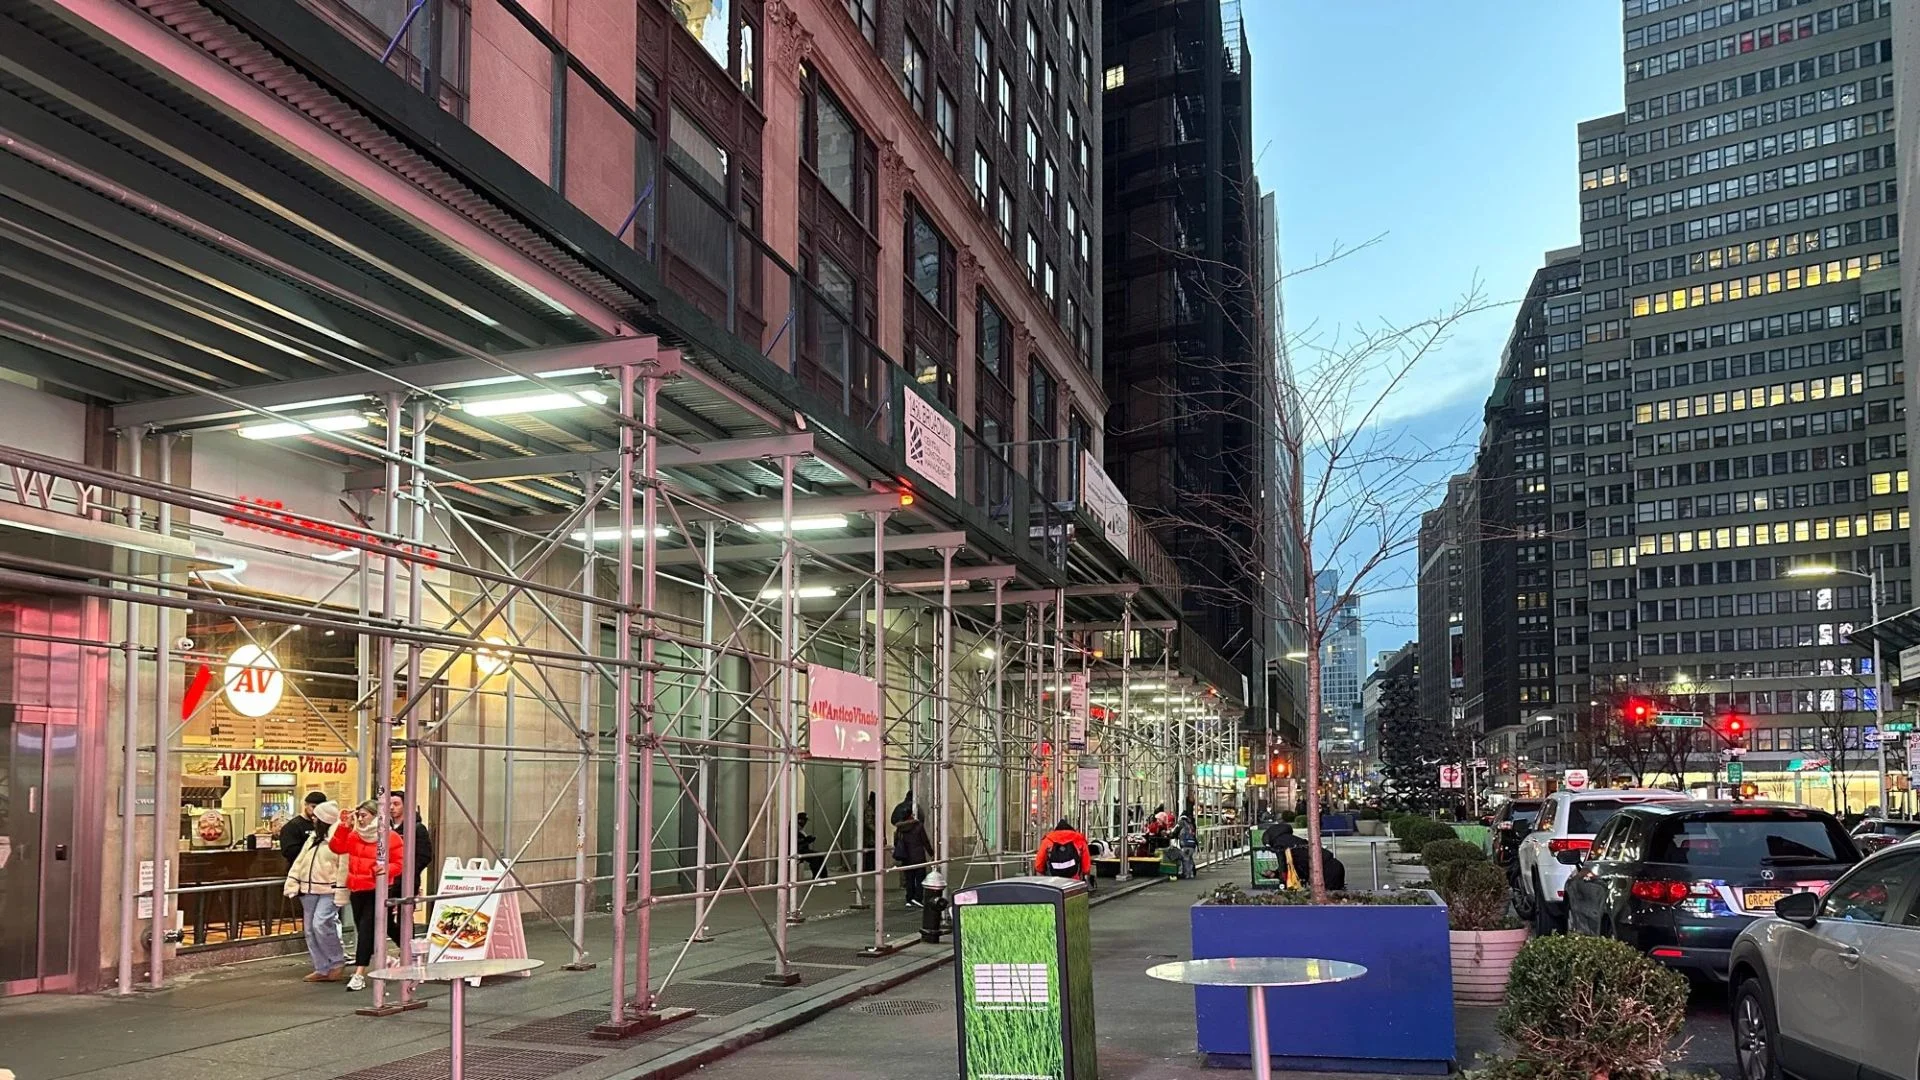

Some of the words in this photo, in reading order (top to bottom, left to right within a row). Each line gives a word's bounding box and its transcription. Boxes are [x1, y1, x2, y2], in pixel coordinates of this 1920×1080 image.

[233, 666, 277, 694] AV
[214, 752, 298, 773] All'Antico
[299, 755, 347, 774] Vinaio
